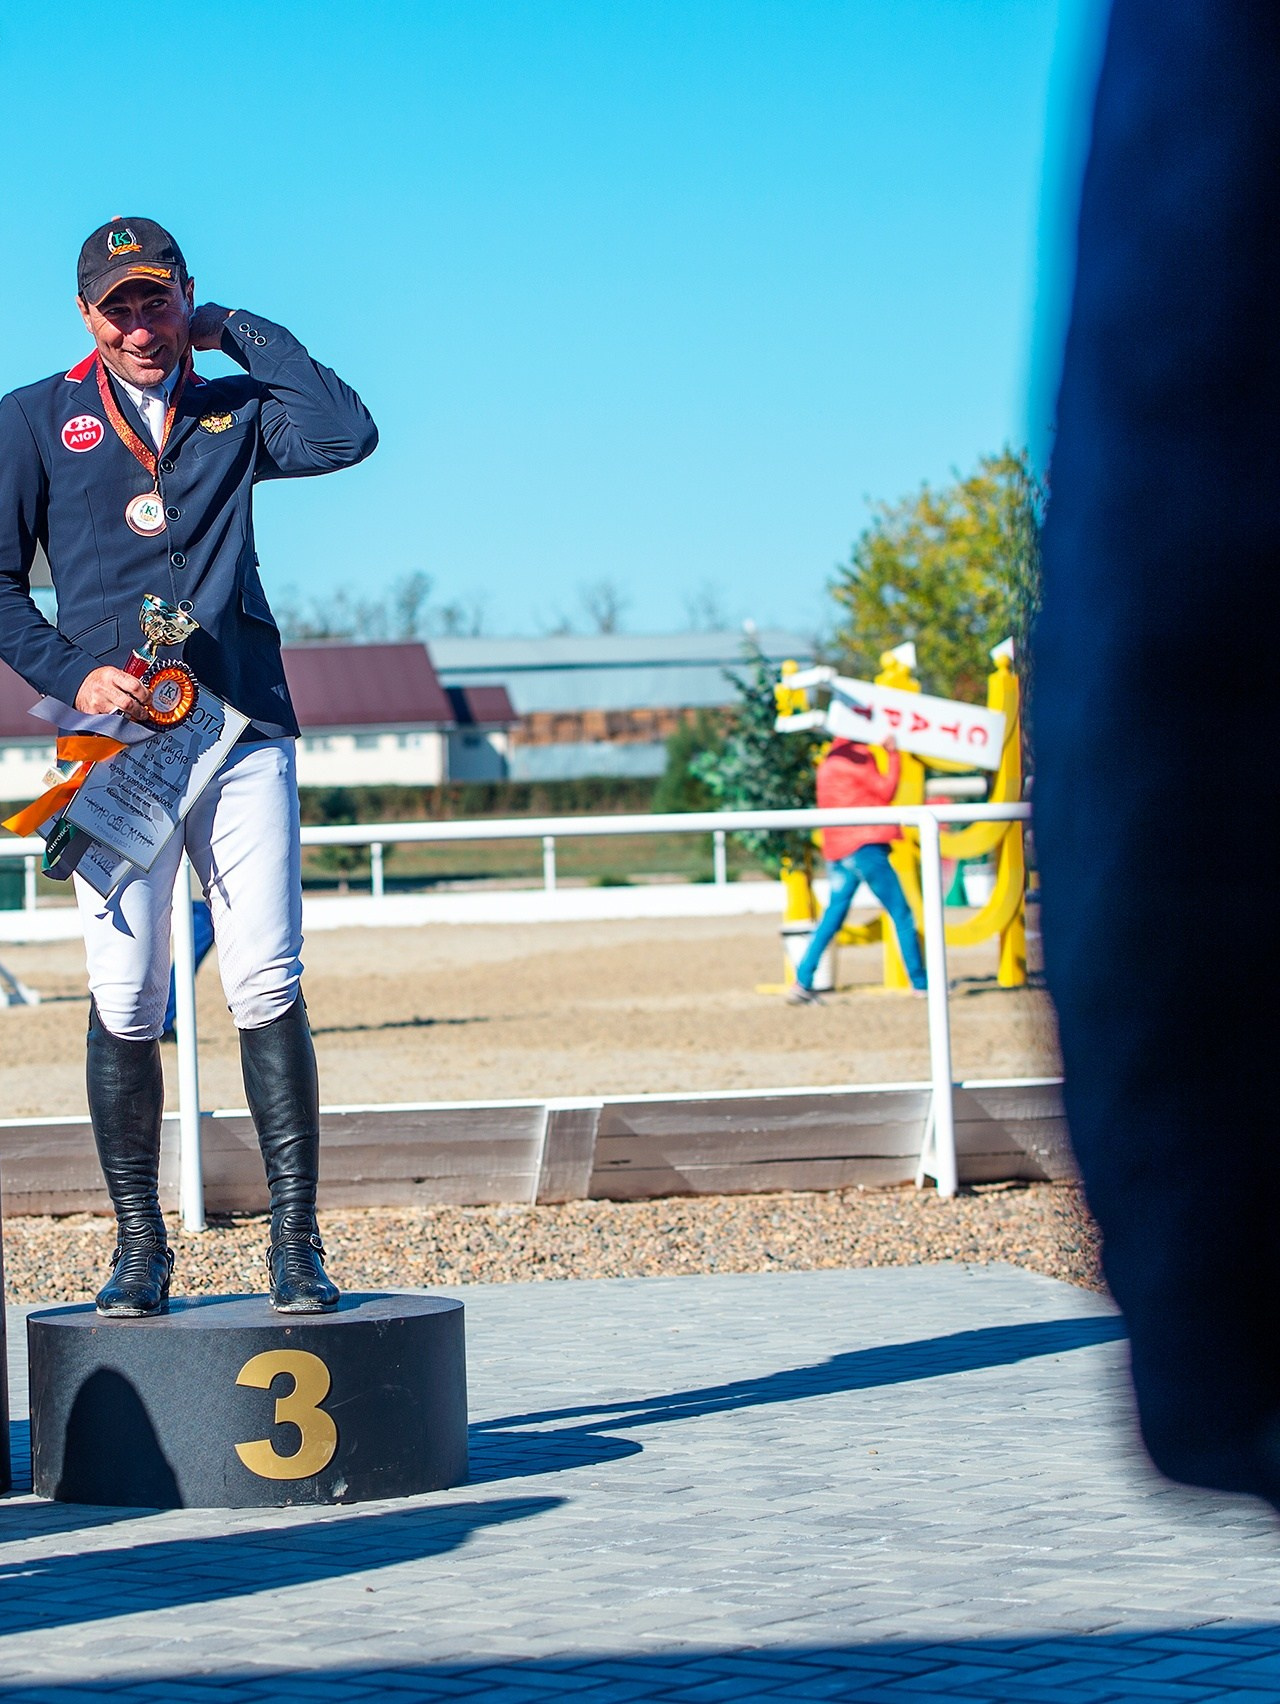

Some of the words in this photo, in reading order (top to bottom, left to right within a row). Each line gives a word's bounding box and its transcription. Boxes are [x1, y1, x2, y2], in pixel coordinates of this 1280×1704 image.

[69, 431, 97, 445] A101
[851, 704, 989, 747] СТАРТ
[48, 821, 71, 854] КИРОВСК
[84, 797, 154, 850] КИРОВСКИЙ
[233, 1348, 340, 1482] 3
